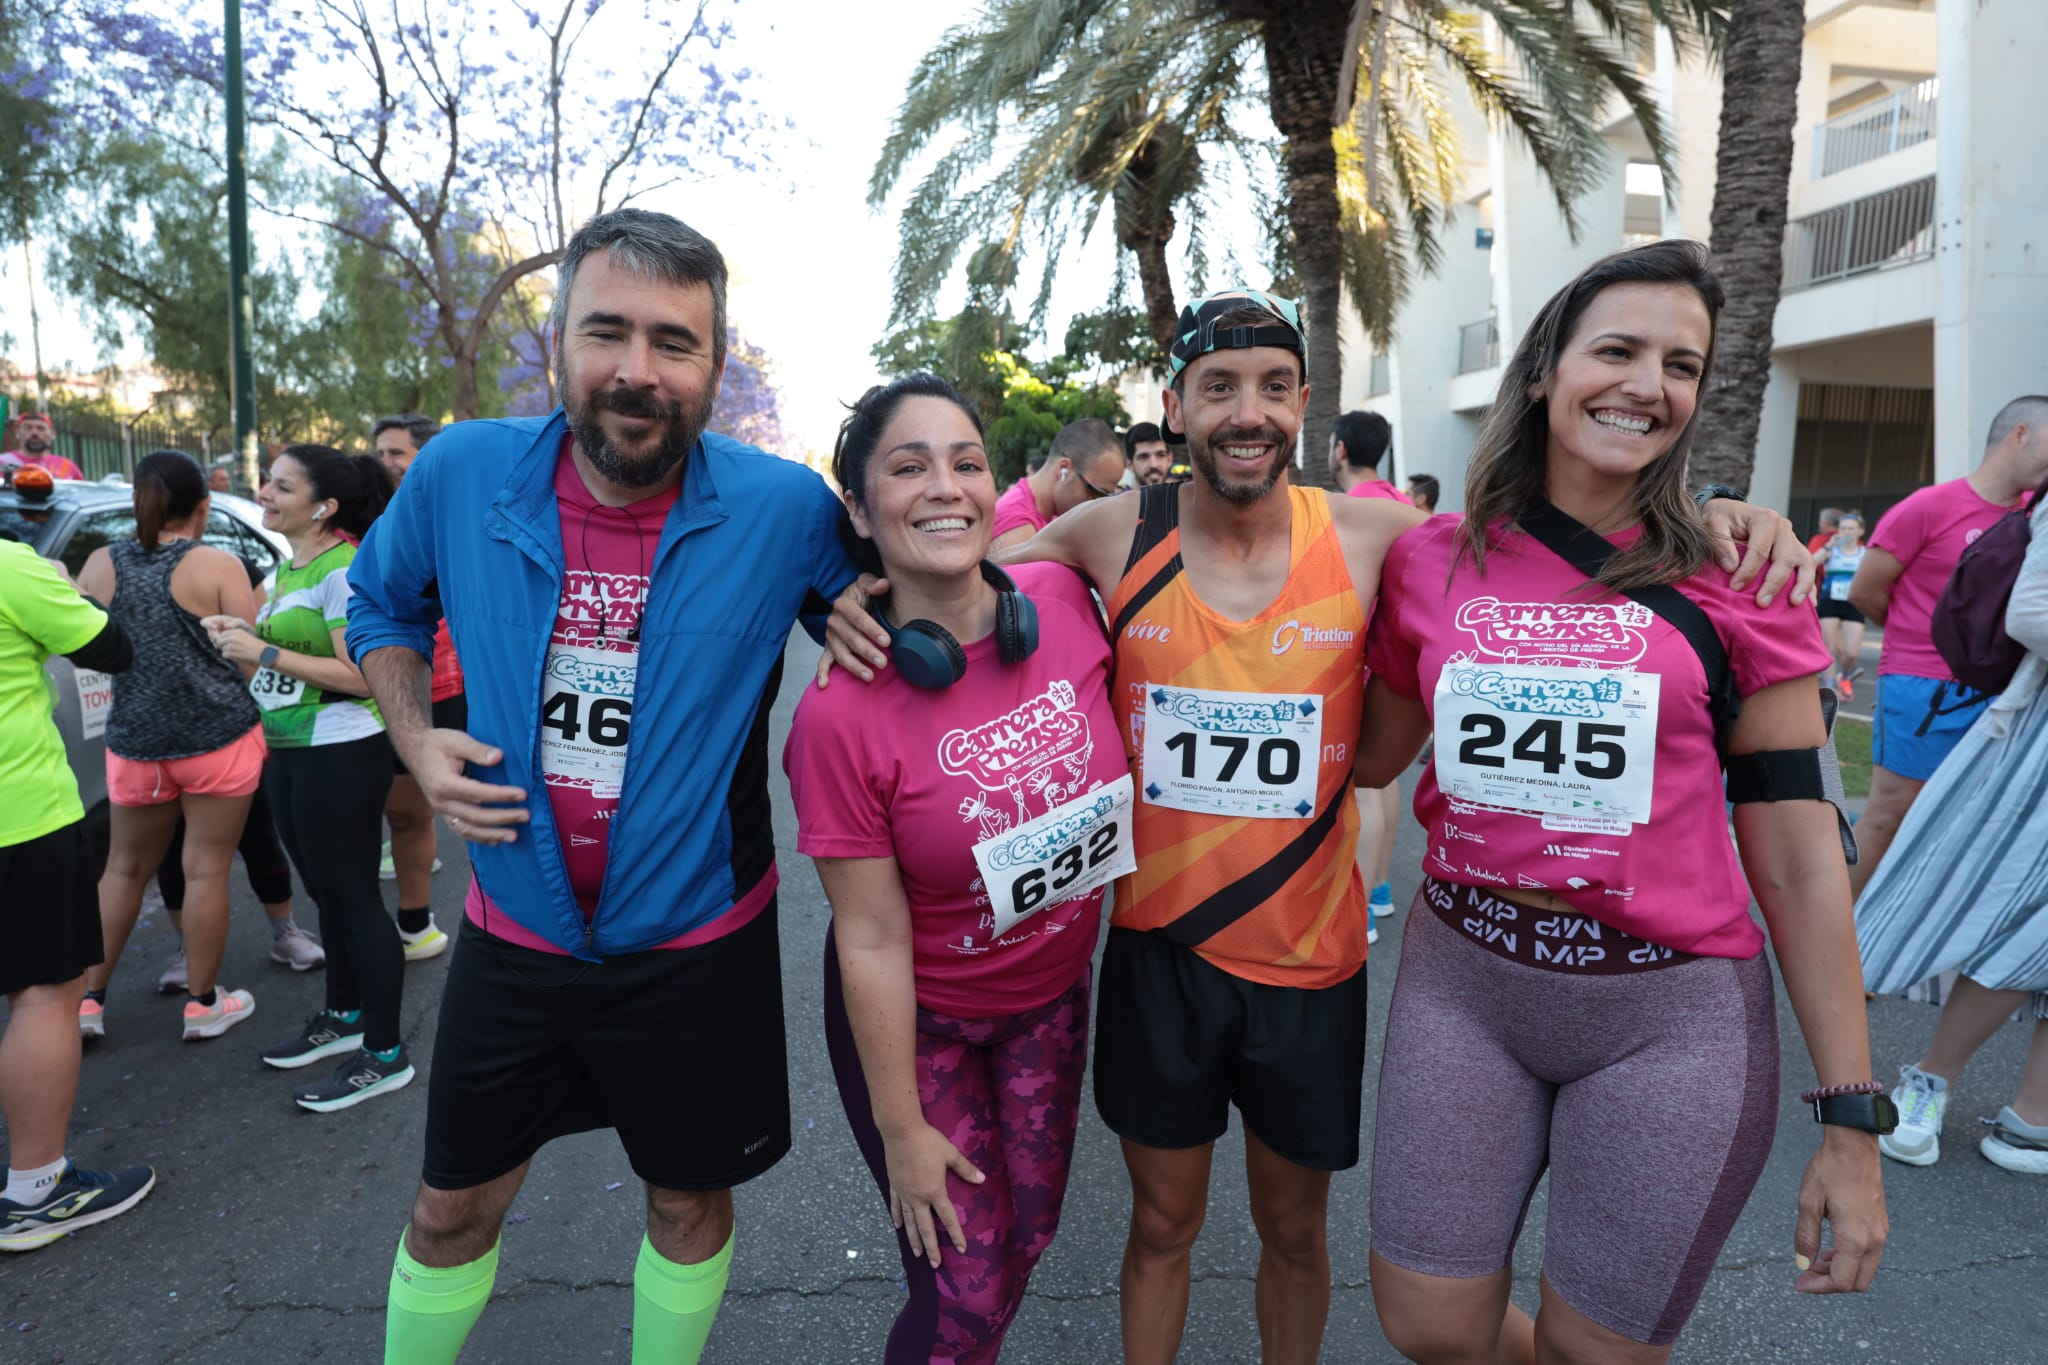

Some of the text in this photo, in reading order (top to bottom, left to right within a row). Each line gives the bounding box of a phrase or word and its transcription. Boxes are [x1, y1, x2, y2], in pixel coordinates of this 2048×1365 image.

[1466, 602, 1617, 622] Carrera
[1622, 604, 1649, 614] de
[1489, 620, 1627, 642] Prensa
[1478, 672, 1596, 699] Carrera
[543, 691, 632, 747] 46
[1178, 698, 1274, 718] Carrera
[1497, 697, 1602, 718] Prensa
[950, 697, 1059, 766] Carrera
[1197, 716, 1280, 734] Prensa
[977, 710, 1077, 775] Prensa
[1459, 713, 1627, 780] 245
[1165, 731, 1300, 785] 170
[1170, 781, 1198, 790] FLORIDO
[1562, 781, 1592, 791] LAURA
[1013, 808, 1098, 860] Carrera
[1032, 818, 1103, 862] Prensa
[1011, 821, 1118, 914] 632
